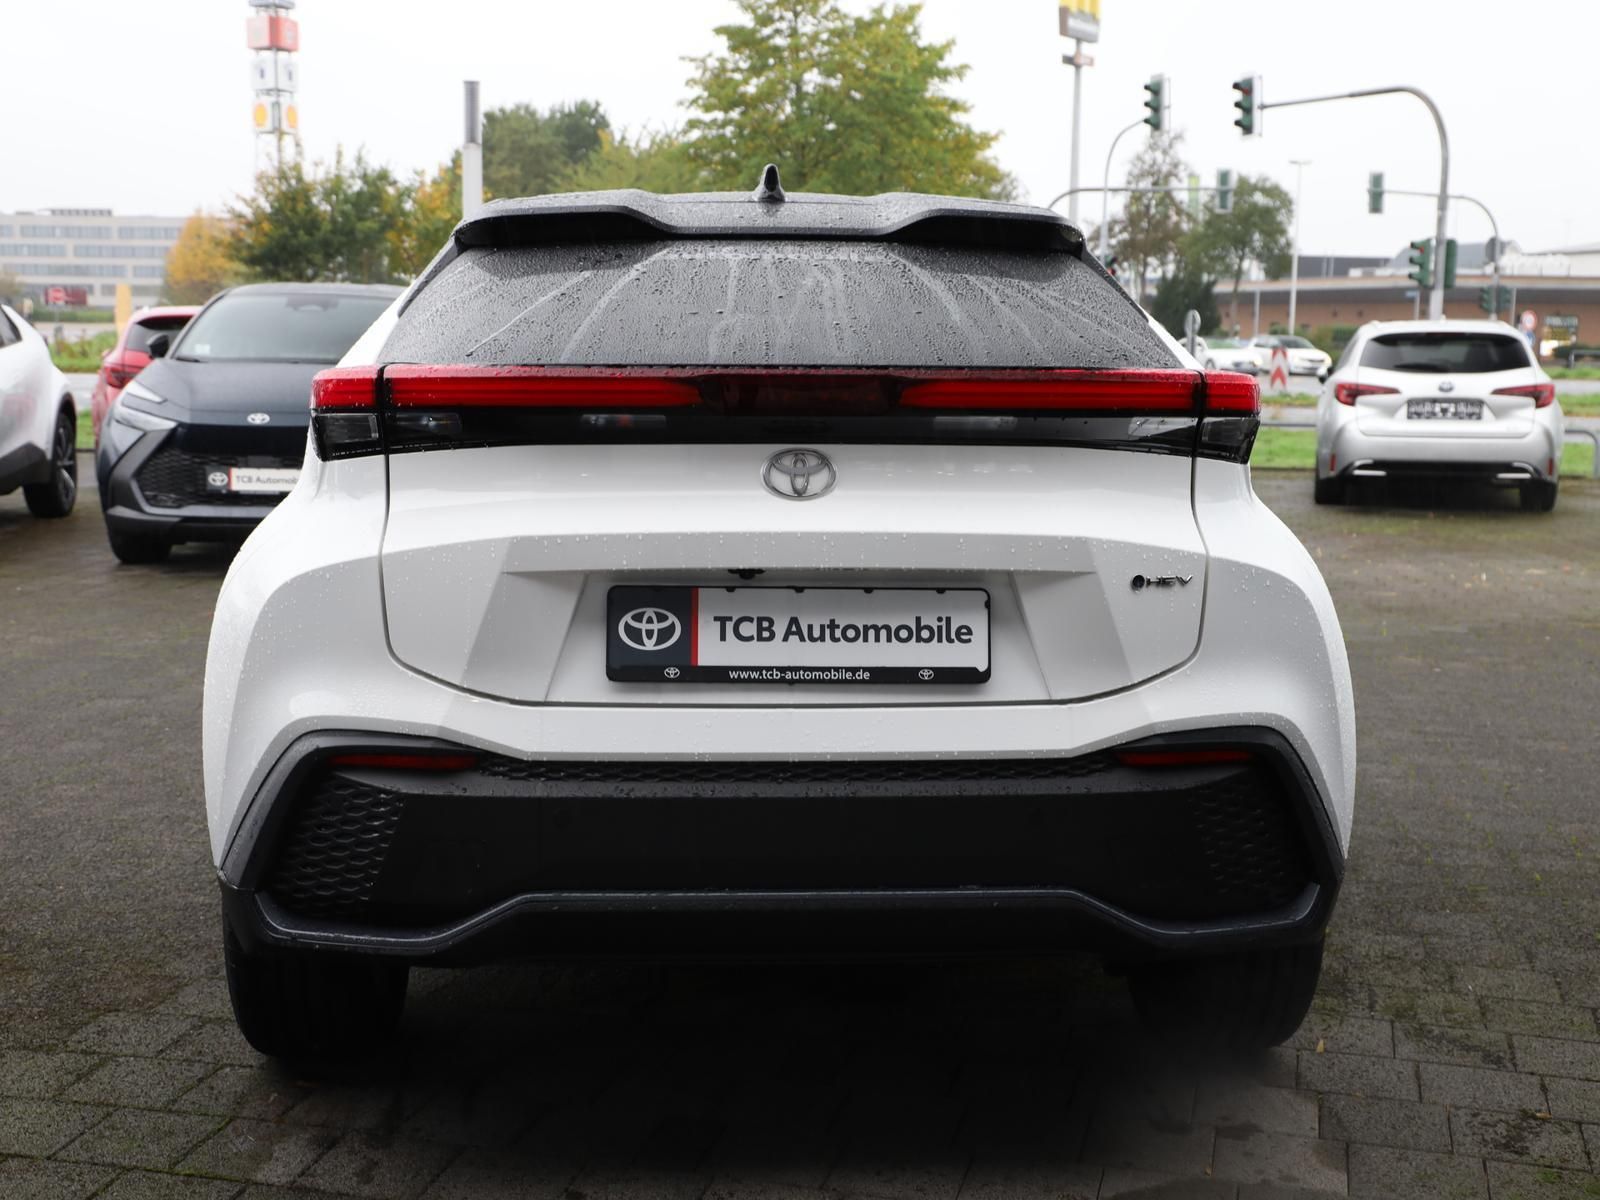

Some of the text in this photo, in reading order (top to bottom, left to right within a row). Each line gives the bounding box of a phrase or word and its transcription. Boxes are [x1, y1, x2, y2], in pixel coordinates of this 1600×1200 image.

[236, 475, 253, 484] TCB
[1145, 575, 1193, 588] HEV
[713, 616, 974, 644] TCB Automobile
[728, 668, 871, 681] www.tcb-automobile.de
